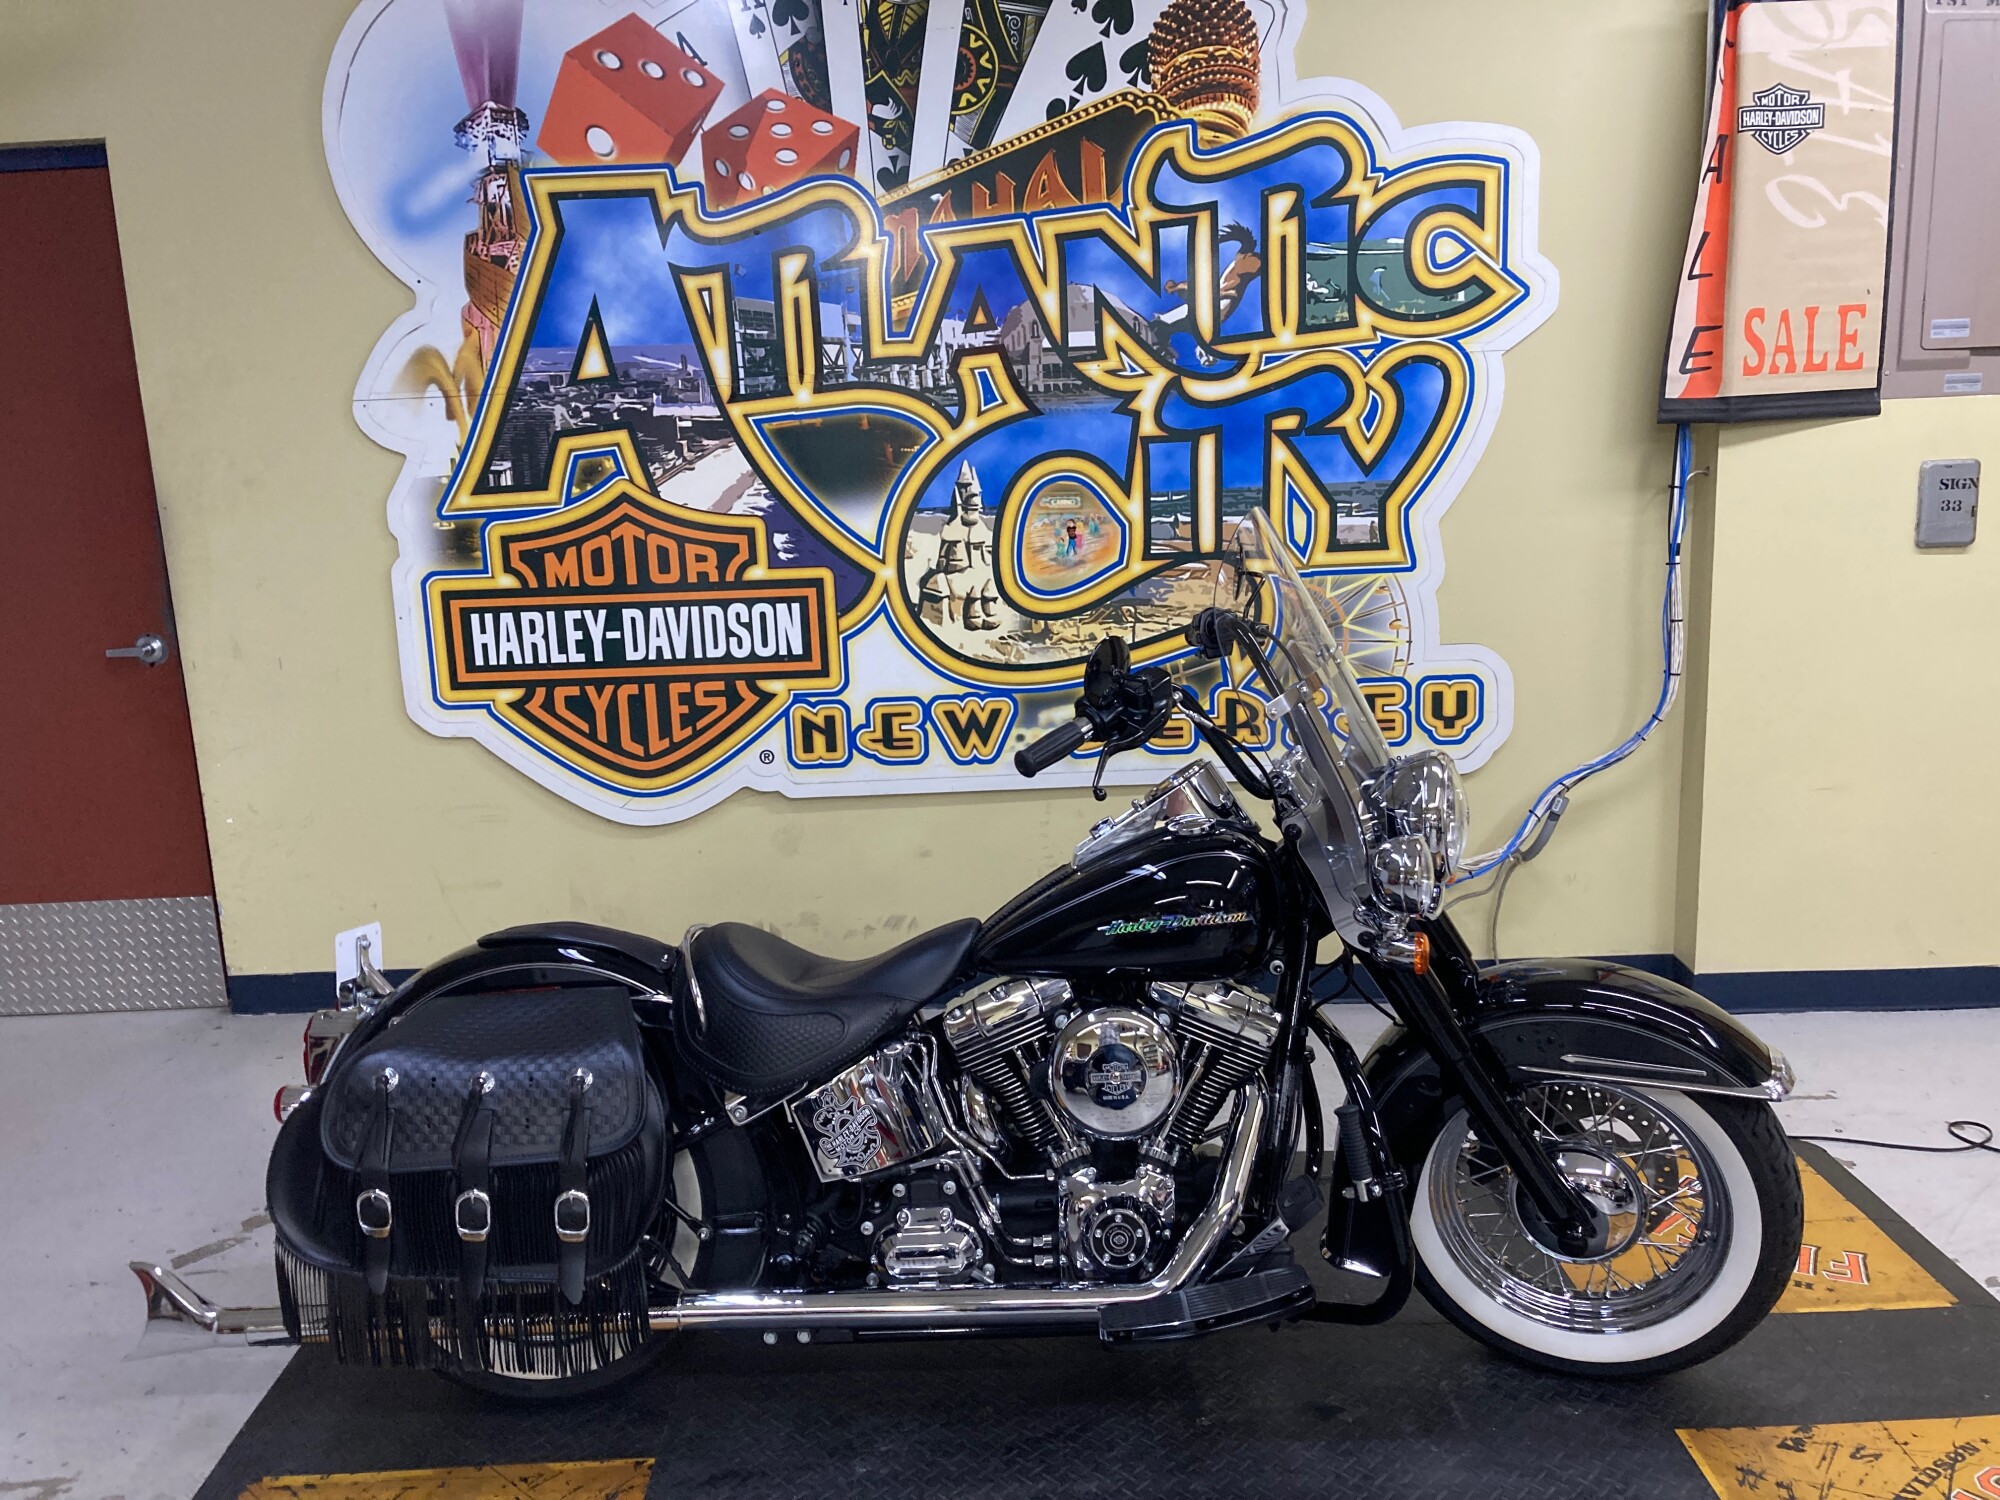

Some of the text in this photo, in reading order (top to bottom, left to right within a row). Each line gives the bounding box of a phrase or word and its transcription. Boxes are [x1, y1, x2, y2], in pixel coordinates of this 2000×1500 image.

[1761, 90, 1800, 106] MOTOR
[1742, 109, 1820, 126] HARLEY-DAVIDSON
[1761, 130, 1799, 149] CYCLES
[1742, 303, 1867, 377] SALE
[1939, 477, 1979, 490] SIGN
[1940, 499, 1962, 512] 33
[544, 521, 719, 587] MOTOR
[469, 602, 803, 666] HARLEY-DAVIDSON
[554, 680, 727, 757] CYCLES
[792, 694, 1013, 767] NEW
[1103, 911, 1249, 935] Harley-Davidson
